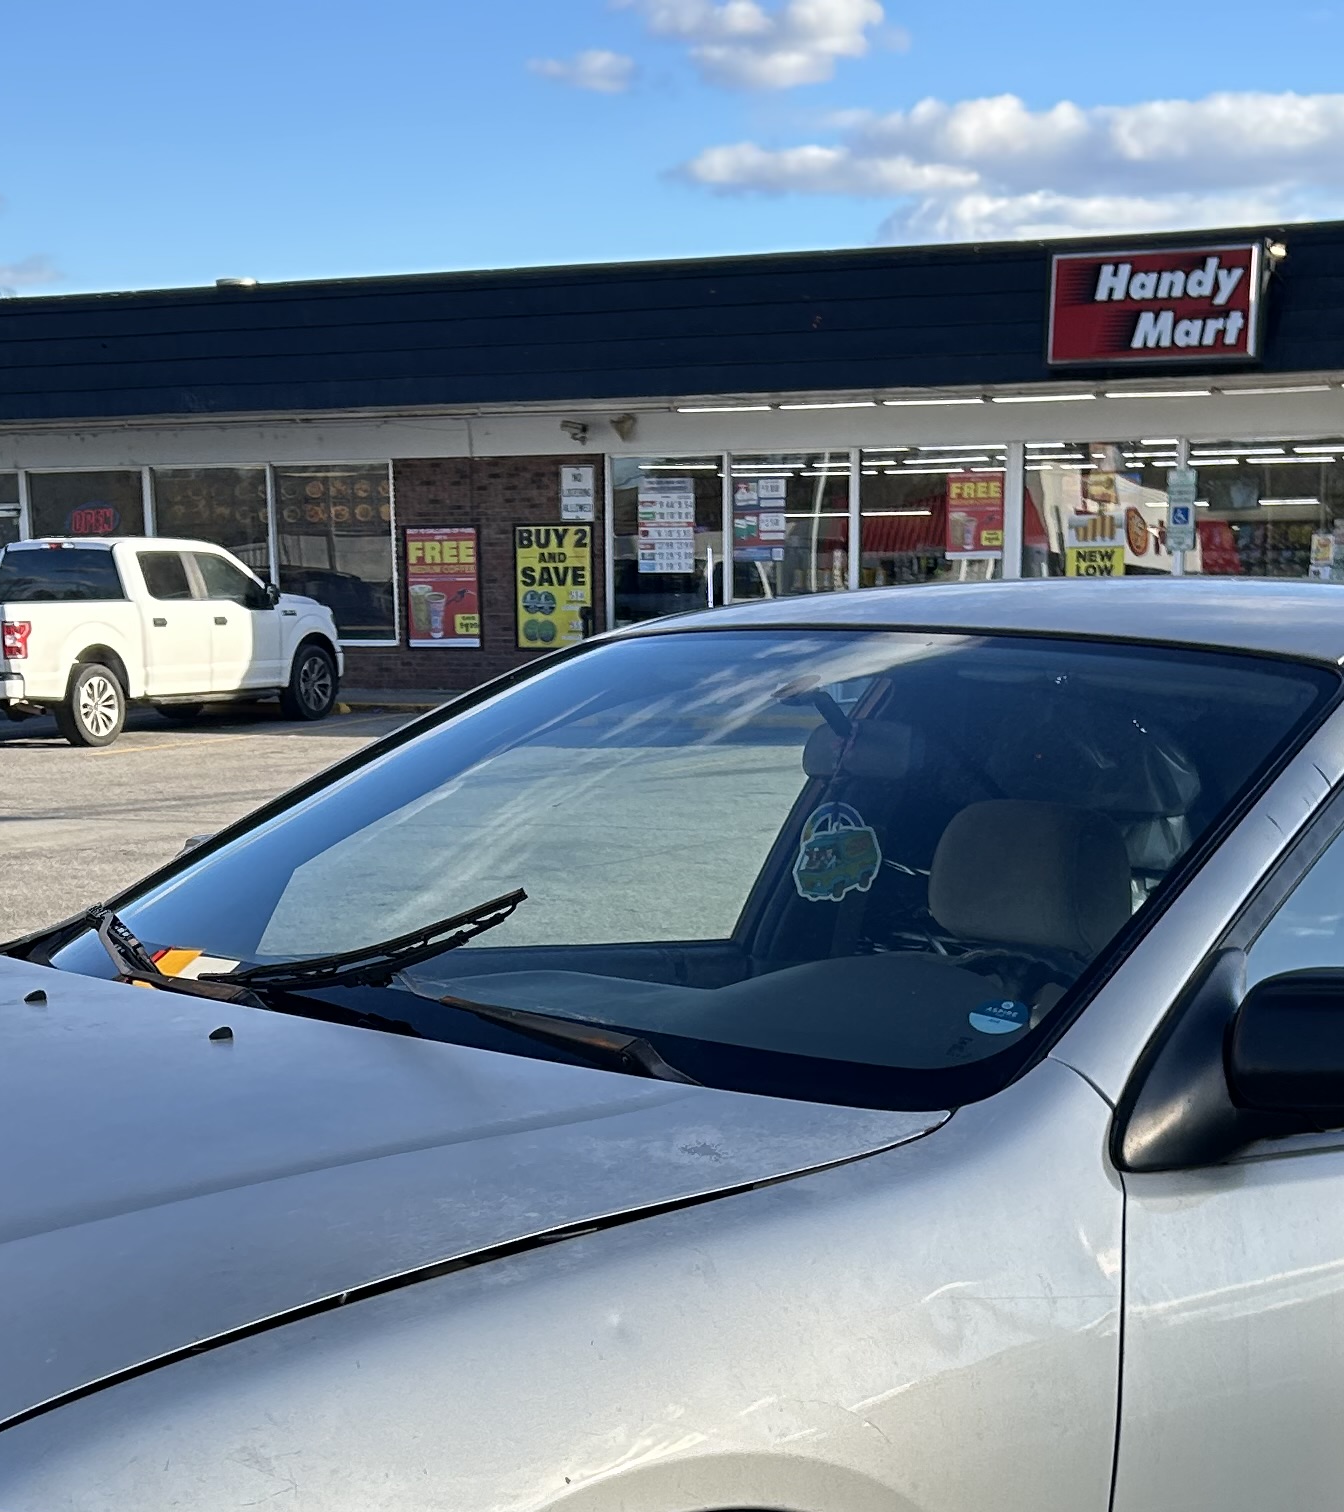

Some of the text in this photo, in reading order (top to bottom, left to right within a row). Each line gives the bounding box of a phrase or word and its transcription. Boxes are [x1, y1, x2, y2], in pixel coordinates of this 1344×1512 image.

[1094, 256, 1245, 306] Handy
[1130, 310, 1244, 349] Mart
[950, 480, 1002, 498] FREE
[71, 507, 114, 534] OPEN
[517, 528, 588, 549] BUY 2
[408, 541, 476, 564] FREE
[537, 551, 568, 564] AND
[1075, 549, 1116, 563] NEW
[520, 565, 586, 587] SAVE
[1075, 563, 1115, 577] LOW
[985, 1006, 1019, 1018] ASPIRE
